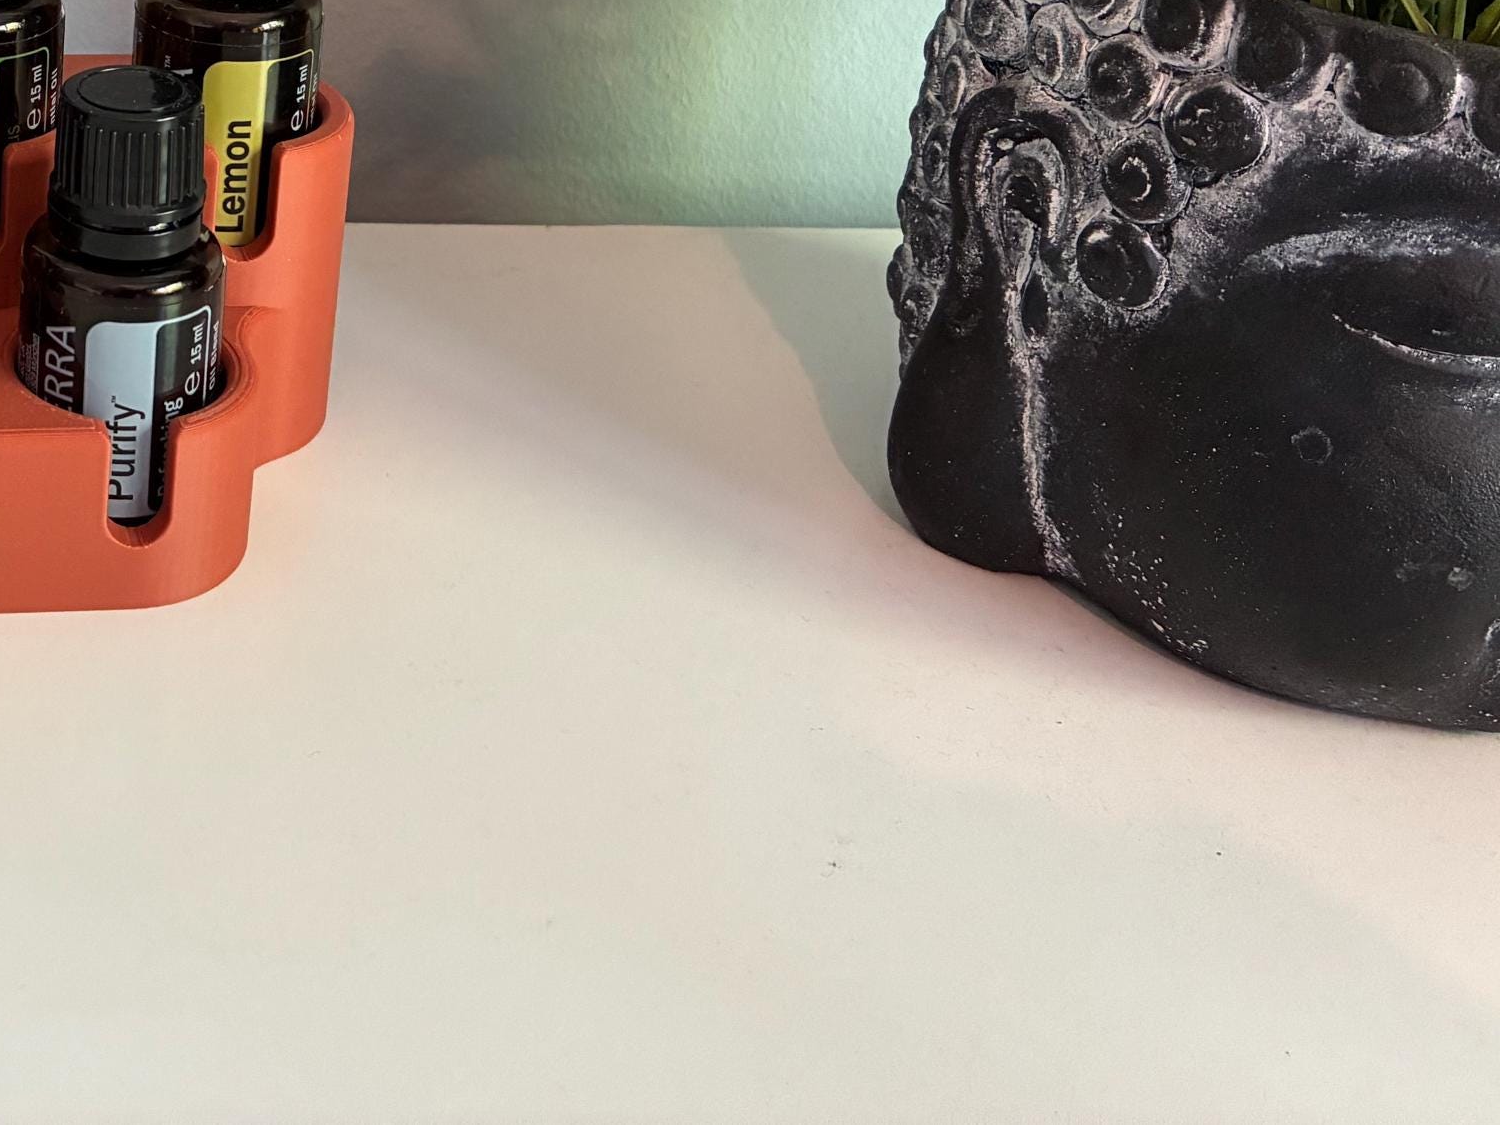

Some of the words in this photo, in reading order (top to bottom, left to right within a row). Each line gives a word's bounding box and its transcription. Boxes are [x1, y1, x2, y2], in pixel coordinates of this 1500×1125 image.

[31, 63, 43, 83] ml
[298, 64, 309, 83] ml
[30, 84, 42, 103] 15
[296, 84, 306, 103] 15
[214, 119, 252, 233] Lemon
[191, 323, 204, 343] ml
[190, 345, 203, 365] 15
